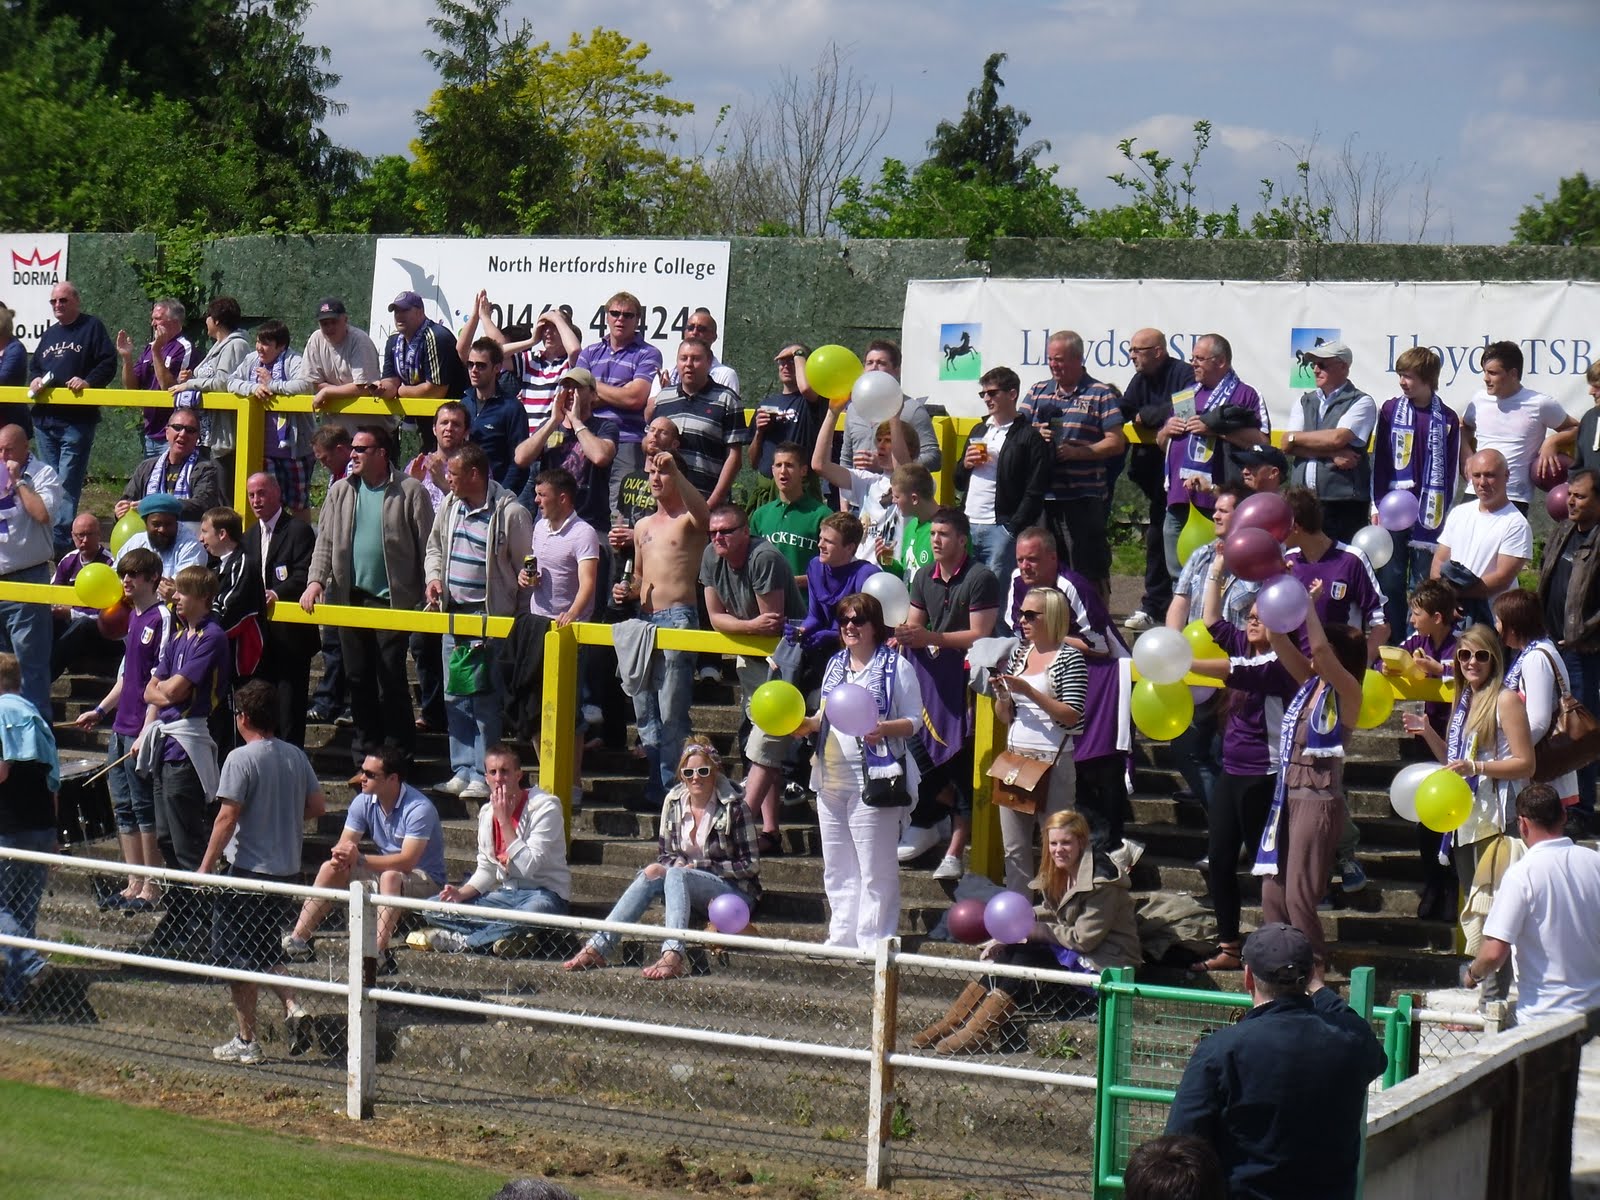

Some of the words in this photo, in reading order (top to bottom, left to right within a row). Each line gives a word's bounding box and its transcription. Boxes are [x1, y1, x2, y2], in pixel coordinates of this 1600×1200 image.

[13, 271, 59, 286] DORMA
[487, 255, 532, 273] North
[538, 255, 648, 274] Hertfordshire
[653, 256, 716, 280] College
[42, 341, 83, 359] DALLAS
[1020, 328, 1132, 368] Llyds
[1521, 338, 1593, 376] TSB
